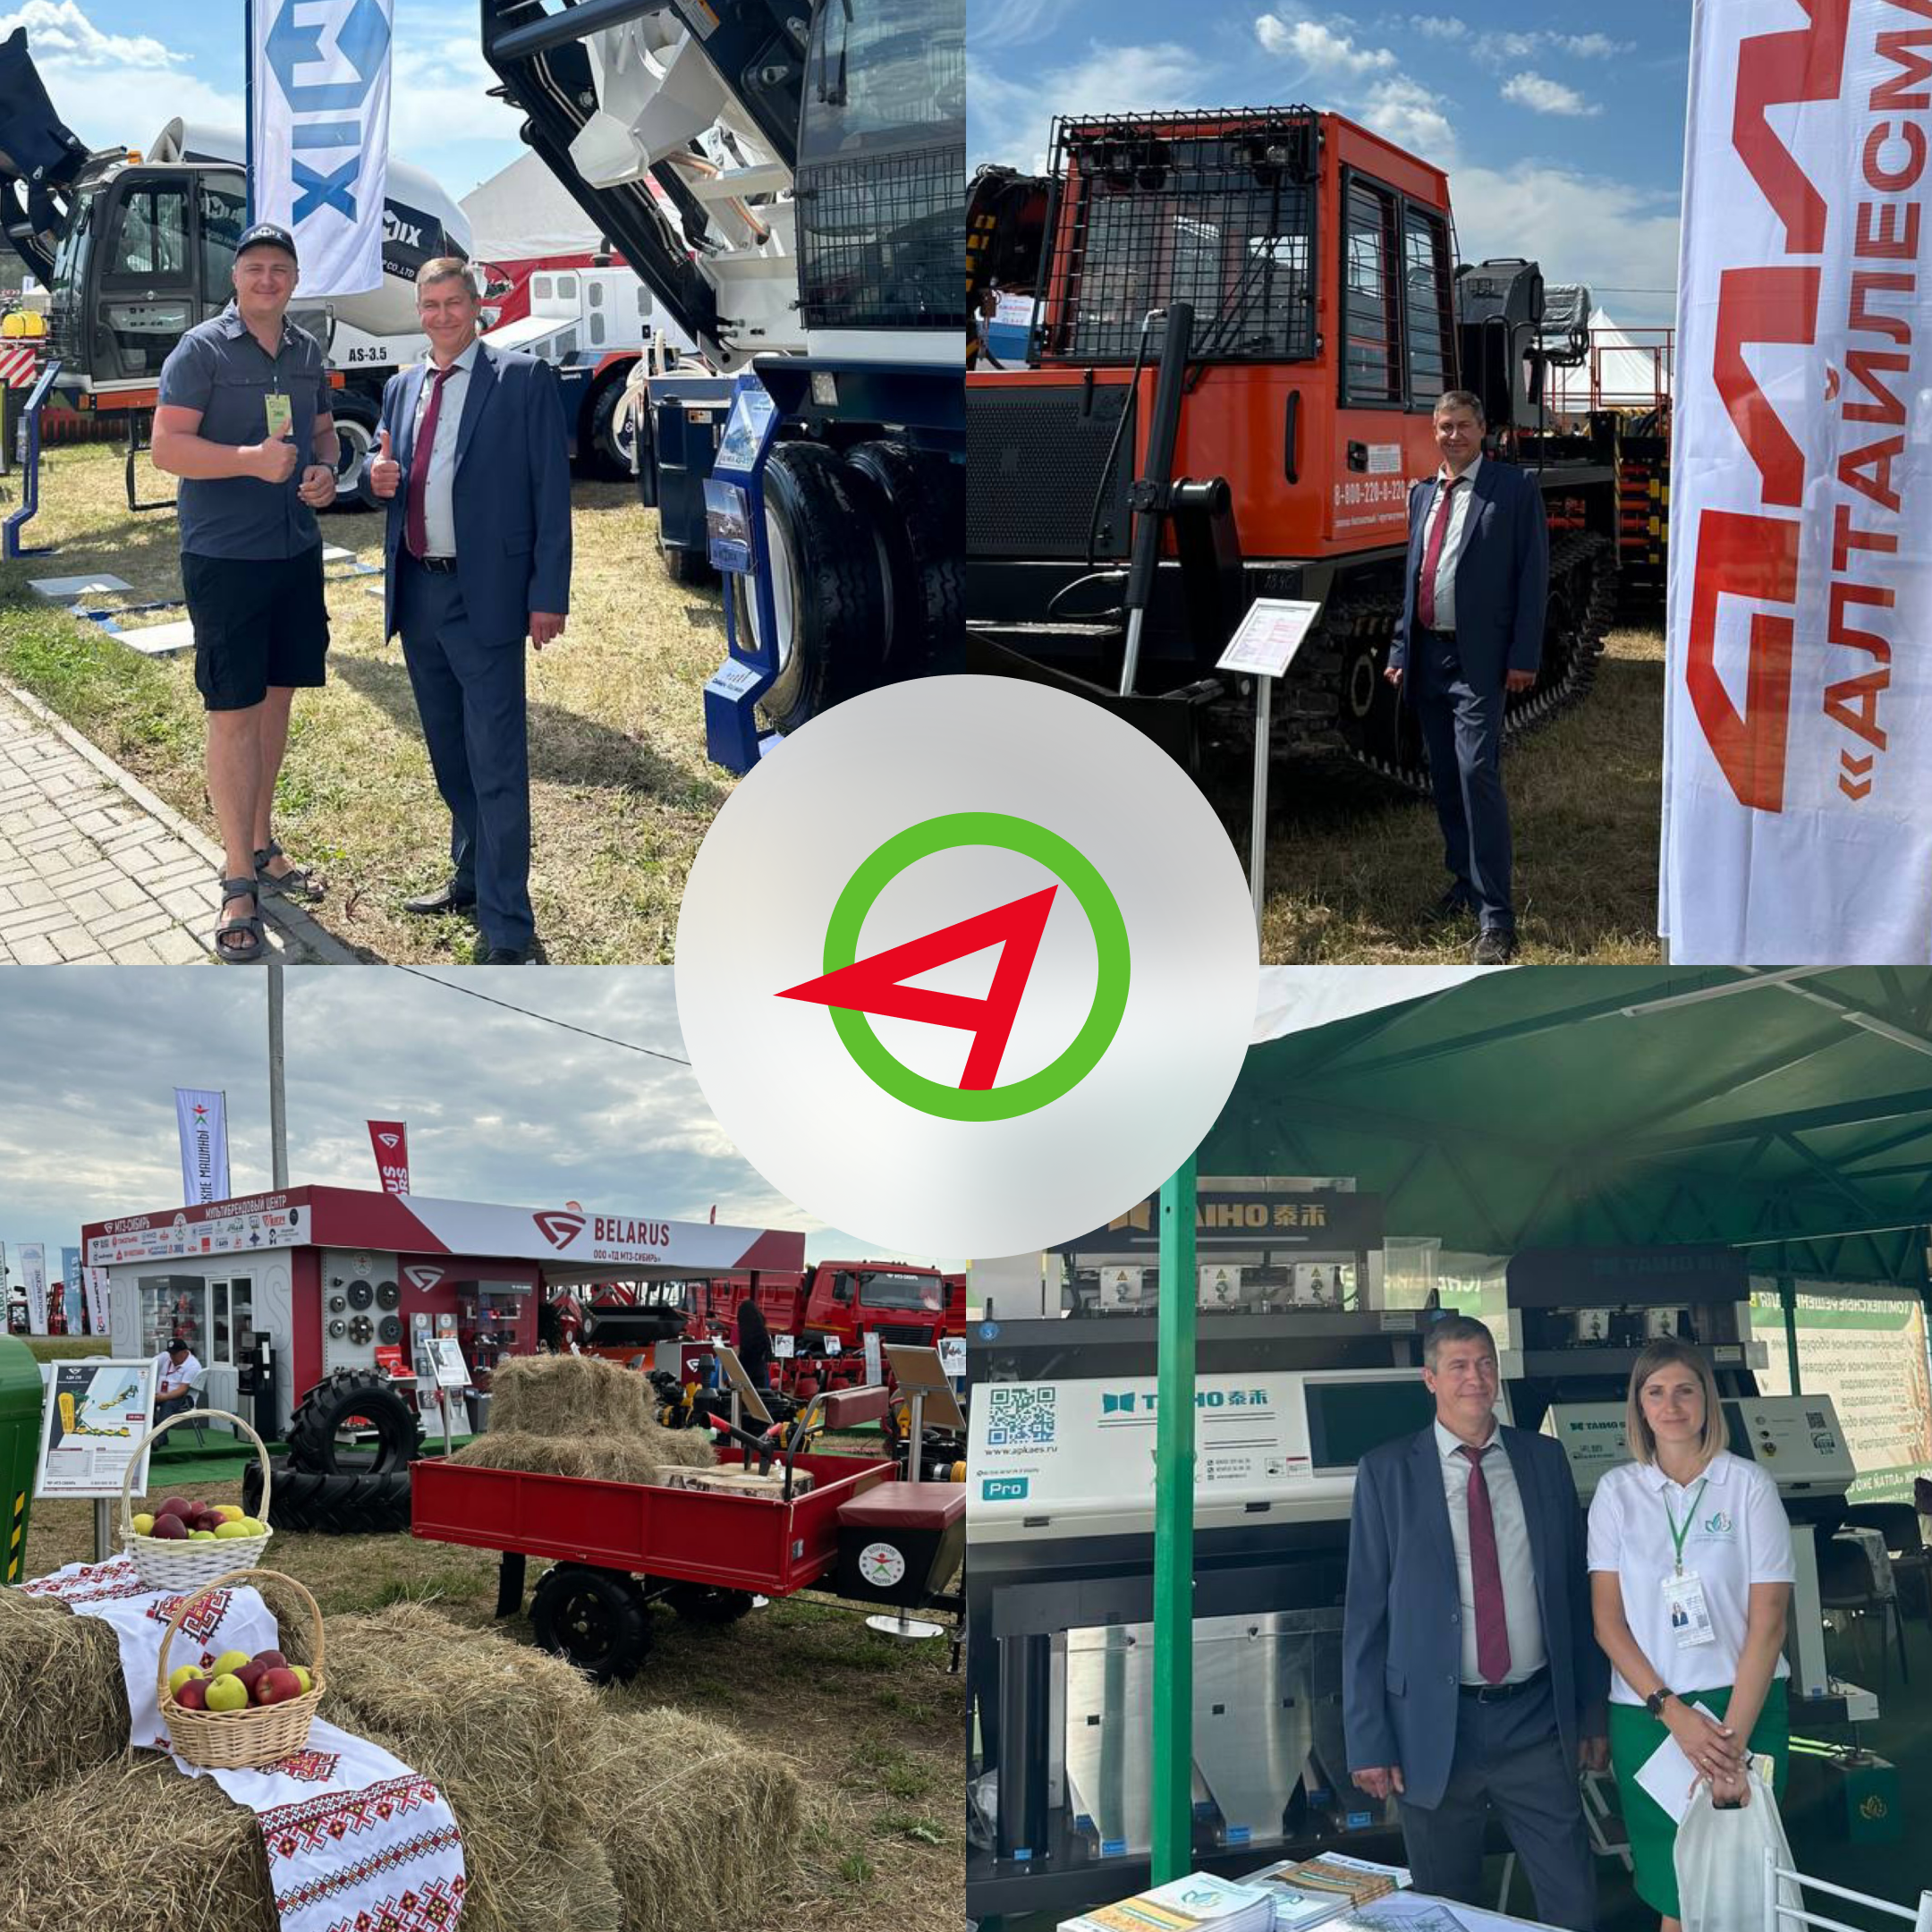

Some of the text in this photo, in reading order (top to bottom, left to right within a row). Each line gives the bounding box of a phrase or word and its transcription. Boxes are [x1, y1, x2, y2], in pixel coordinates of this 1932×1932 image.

[349, 347, 387, 362] AS-3.5
[197, 1130, 211, 1178] МАШИНЫ
[266, 1194, 286, 1210] ЦЕНТР
[114, 1216, 150, 1233] МТЗ-СИБИРЬ
[594, 1217, 670, 1247] BELARUS
[593, 1250, 607, 1259] ООО
[989, 1483, 1021, 1496] Pro
